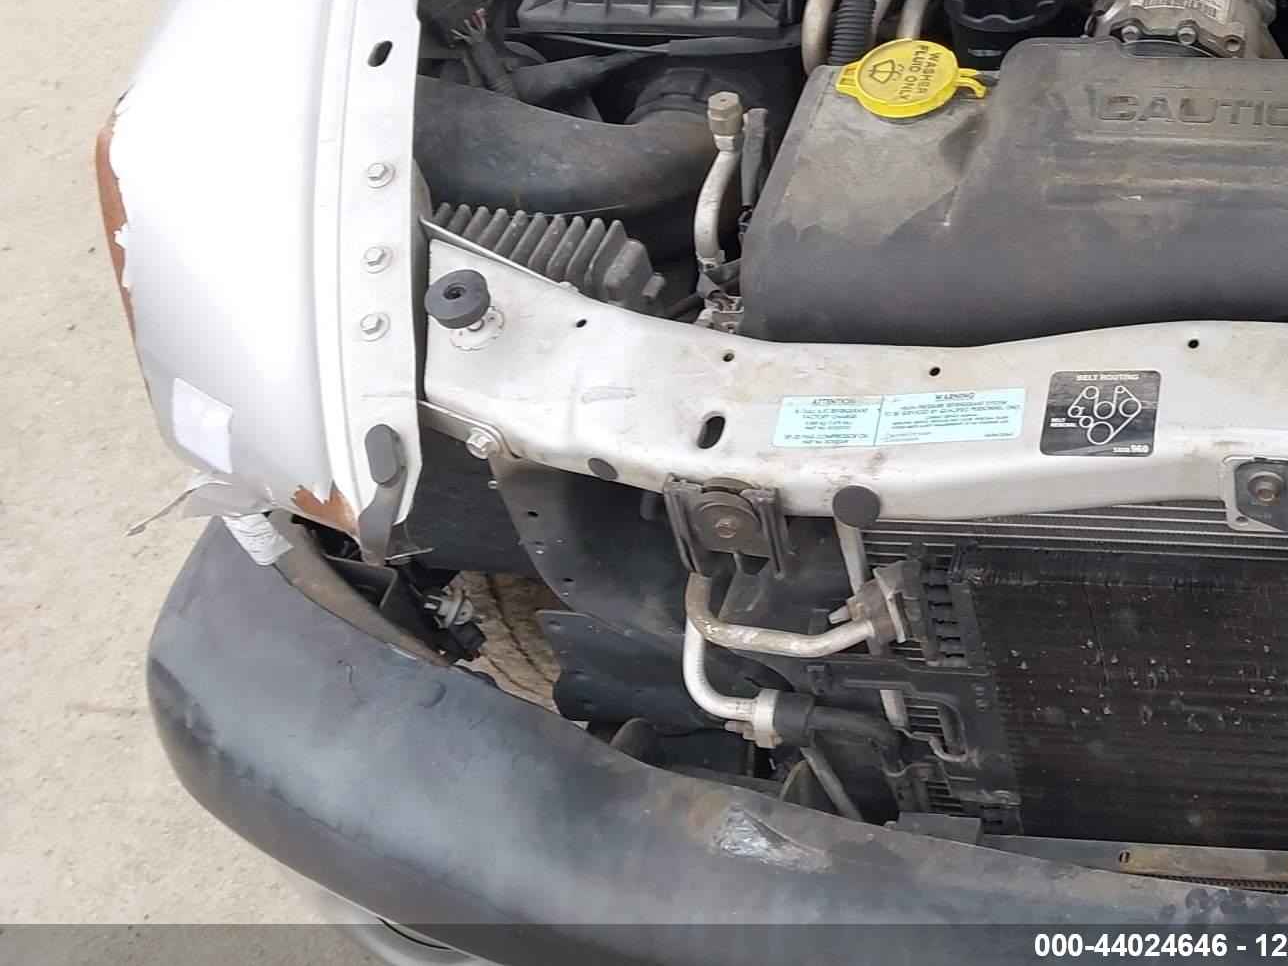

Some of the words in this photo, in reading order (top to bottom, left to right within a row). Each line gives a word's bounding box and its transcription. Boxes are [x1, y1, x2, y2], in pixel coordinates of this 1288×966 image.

[909, 45, 928, 74] FLUID
[916, 52, 942, 95] WASHER
[898, 75, 914, 101] ONLY
